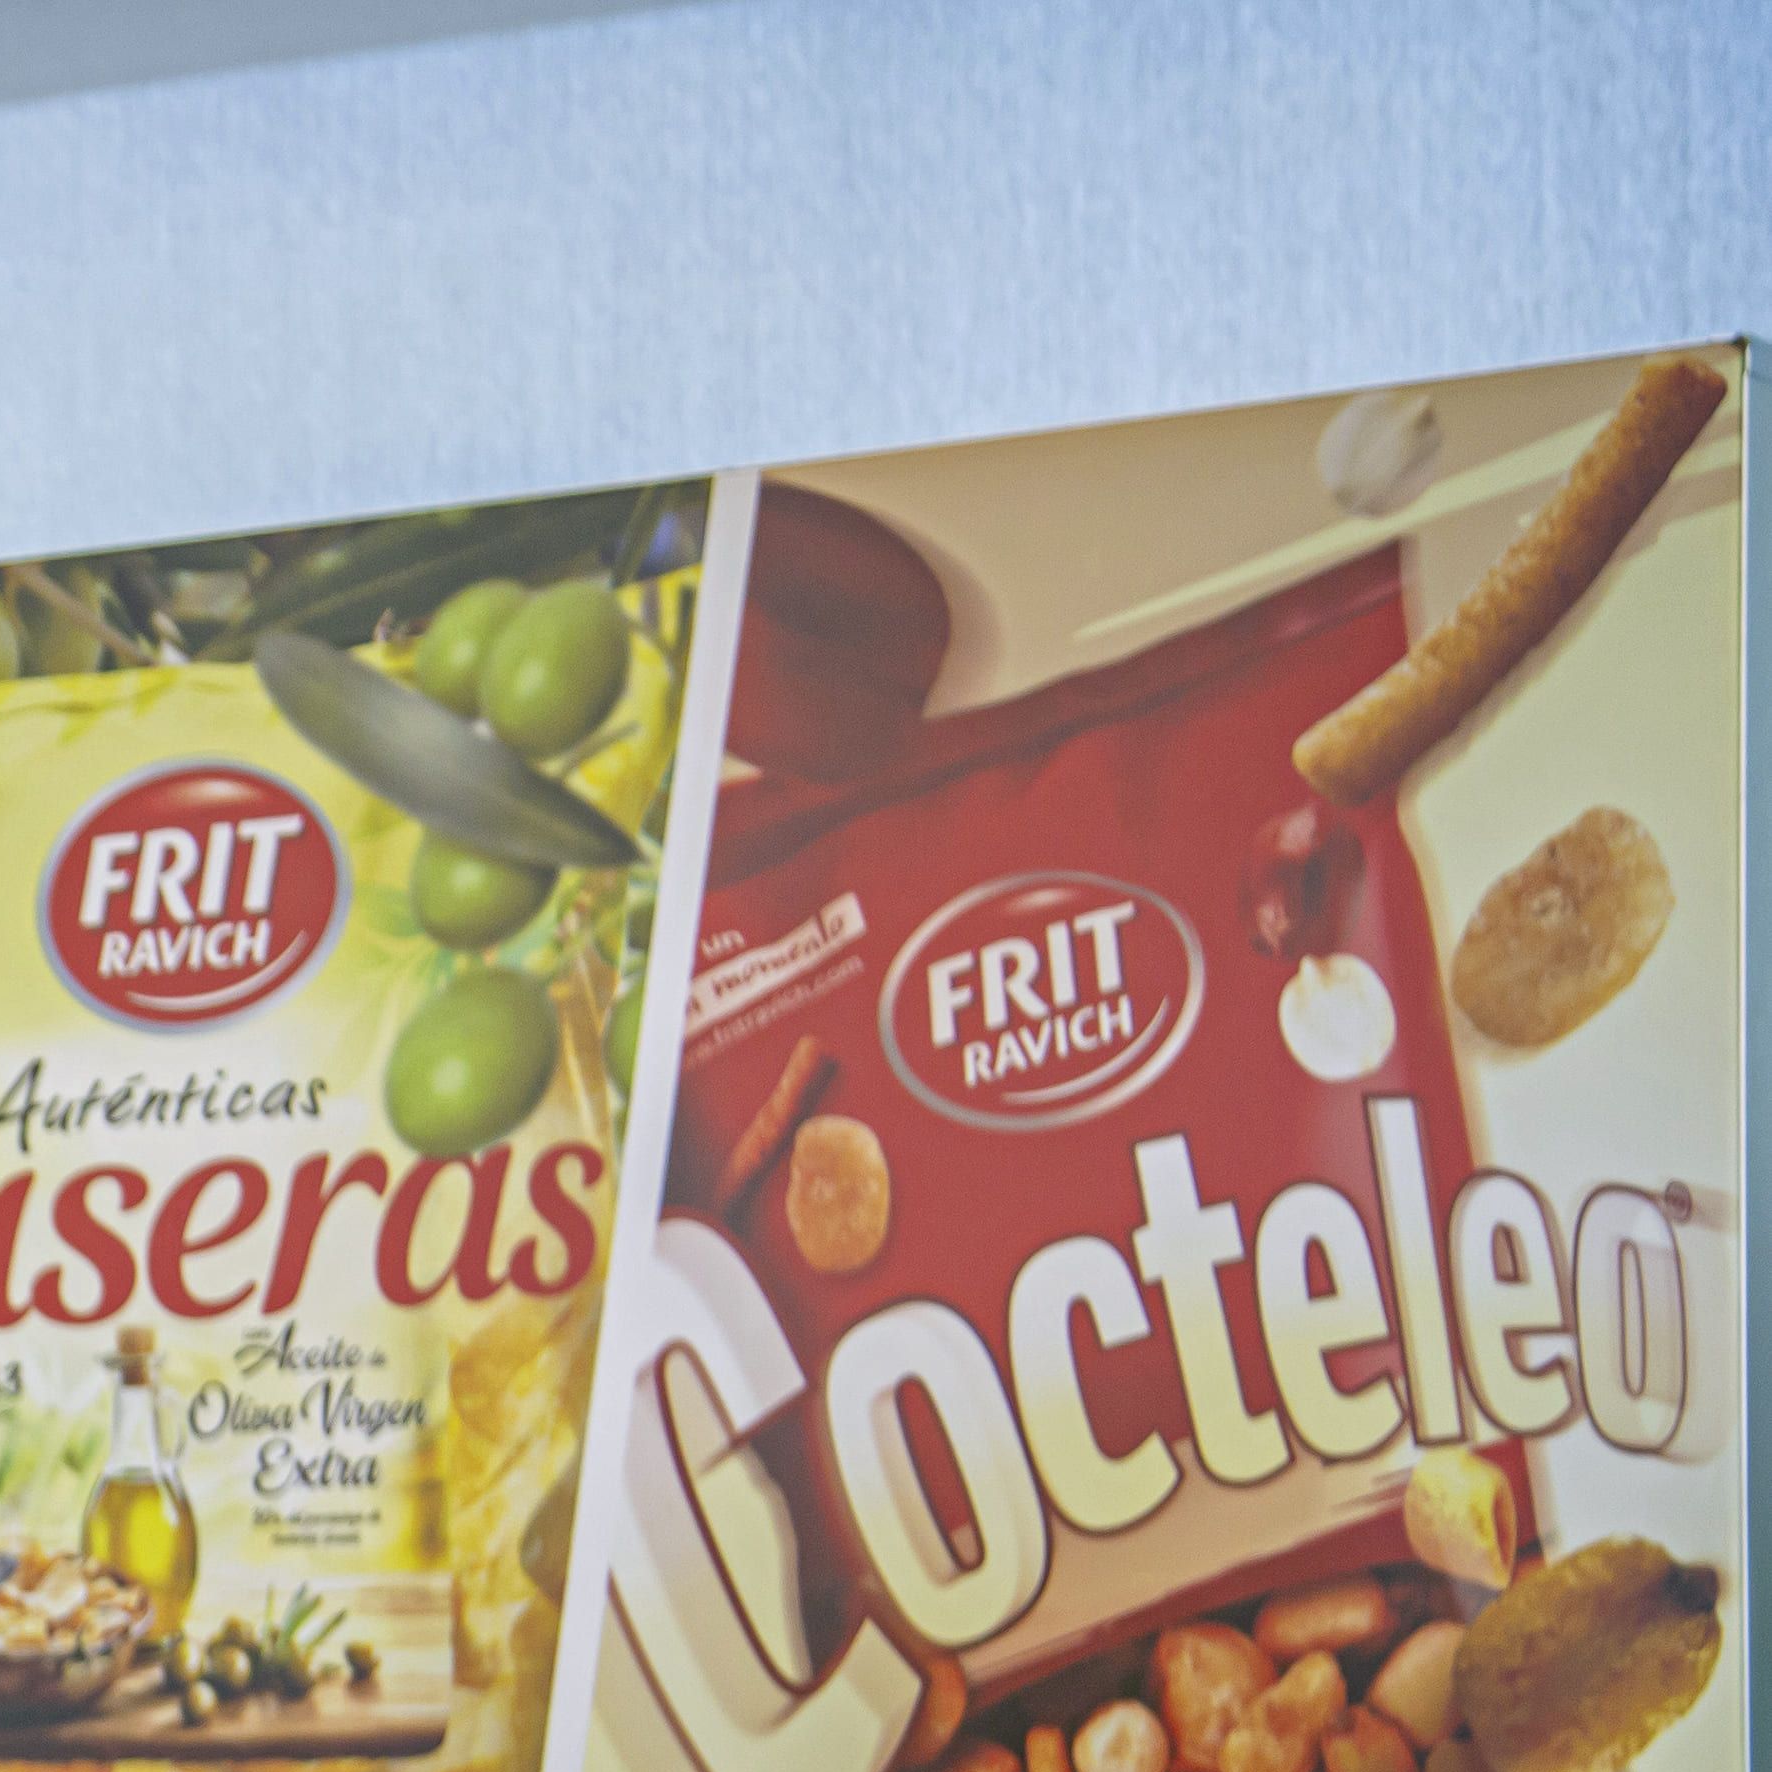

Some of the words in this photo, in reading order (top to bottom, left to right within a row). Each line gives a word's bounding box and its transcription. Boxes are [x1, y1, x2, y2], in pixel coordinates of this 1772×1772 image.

[77, 813, 305, 928] FRIT
[97, 920, 271, 978] RAVICH
[925, 901, 1136, 1049] FRIT
[962, 992, 1135, 1089] RAVICH
[234, 1319, 363, 1378] Aceite
[189, 1378, 293, 1440] Oliva
[300, 1376, 427, 1441] Virgen
[253, 1437, 380, 1496] Extra
